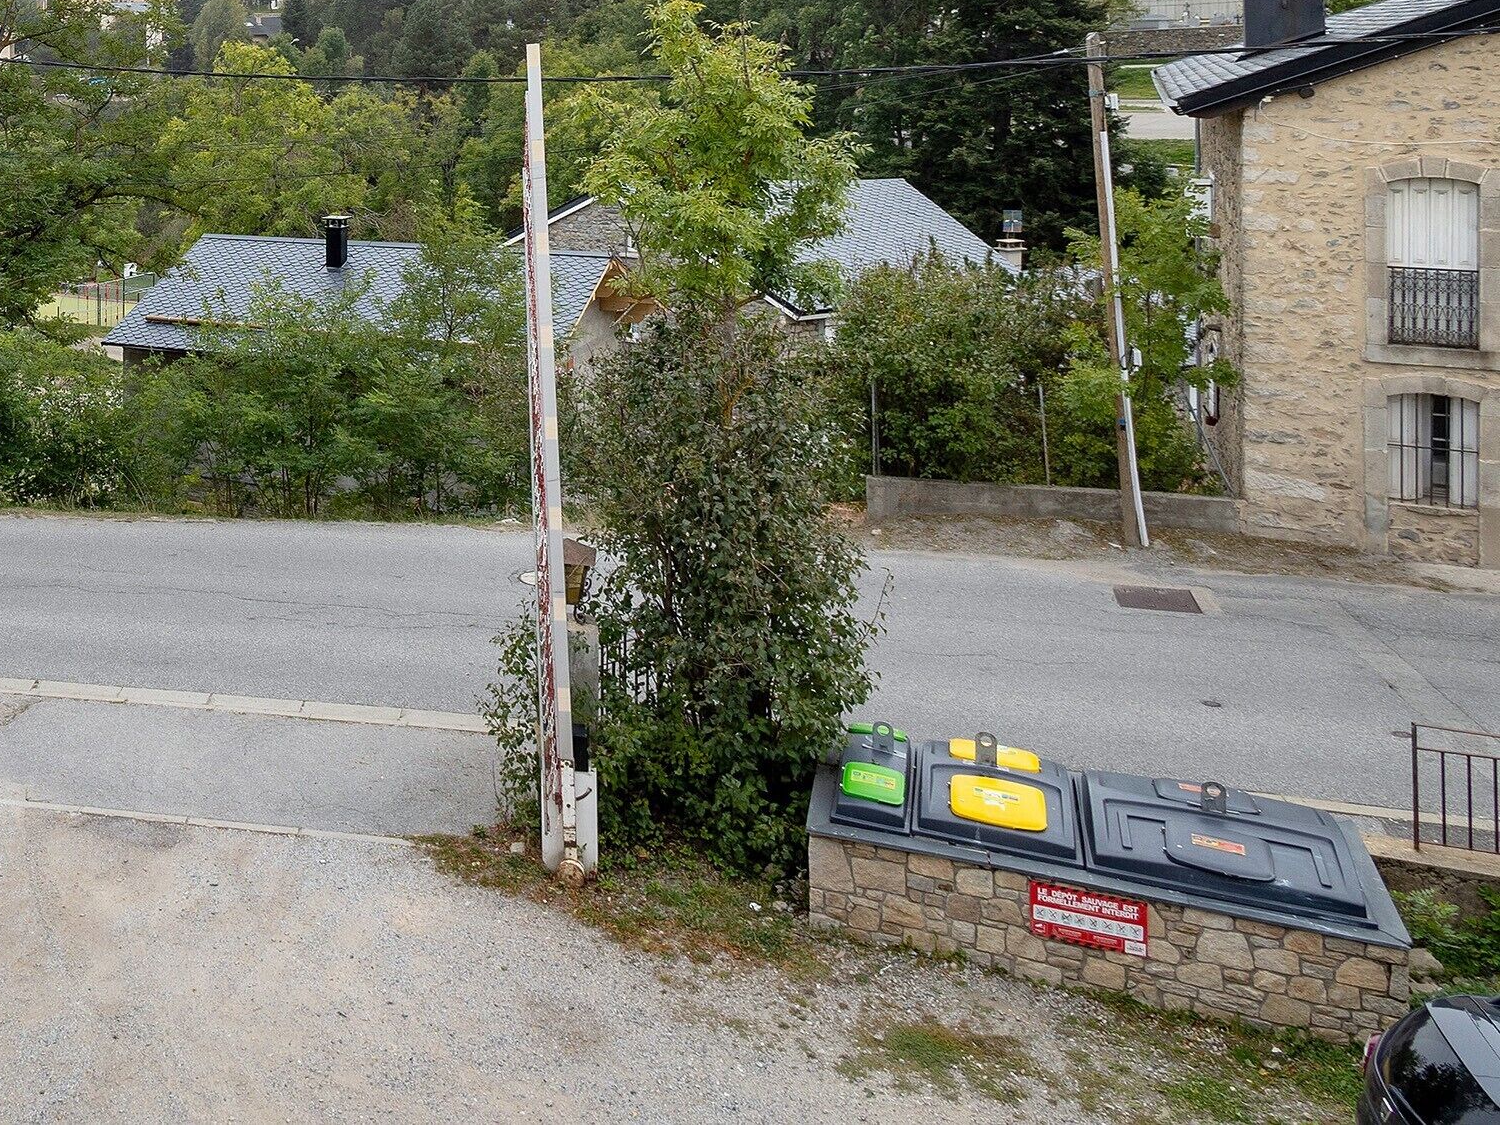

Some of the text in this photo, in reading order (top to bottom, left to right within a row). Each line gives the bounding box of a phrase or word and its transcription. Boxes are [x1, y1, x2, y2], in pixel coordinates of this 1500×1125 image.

[1037, 887, 1047, 895] LE
[1081, 896, 1118, 909] SAUVAGE
[1122, 904, 1139, 913] EST
[1037, 894, 1139, 920] FORMELLEMENT INTERDIT
